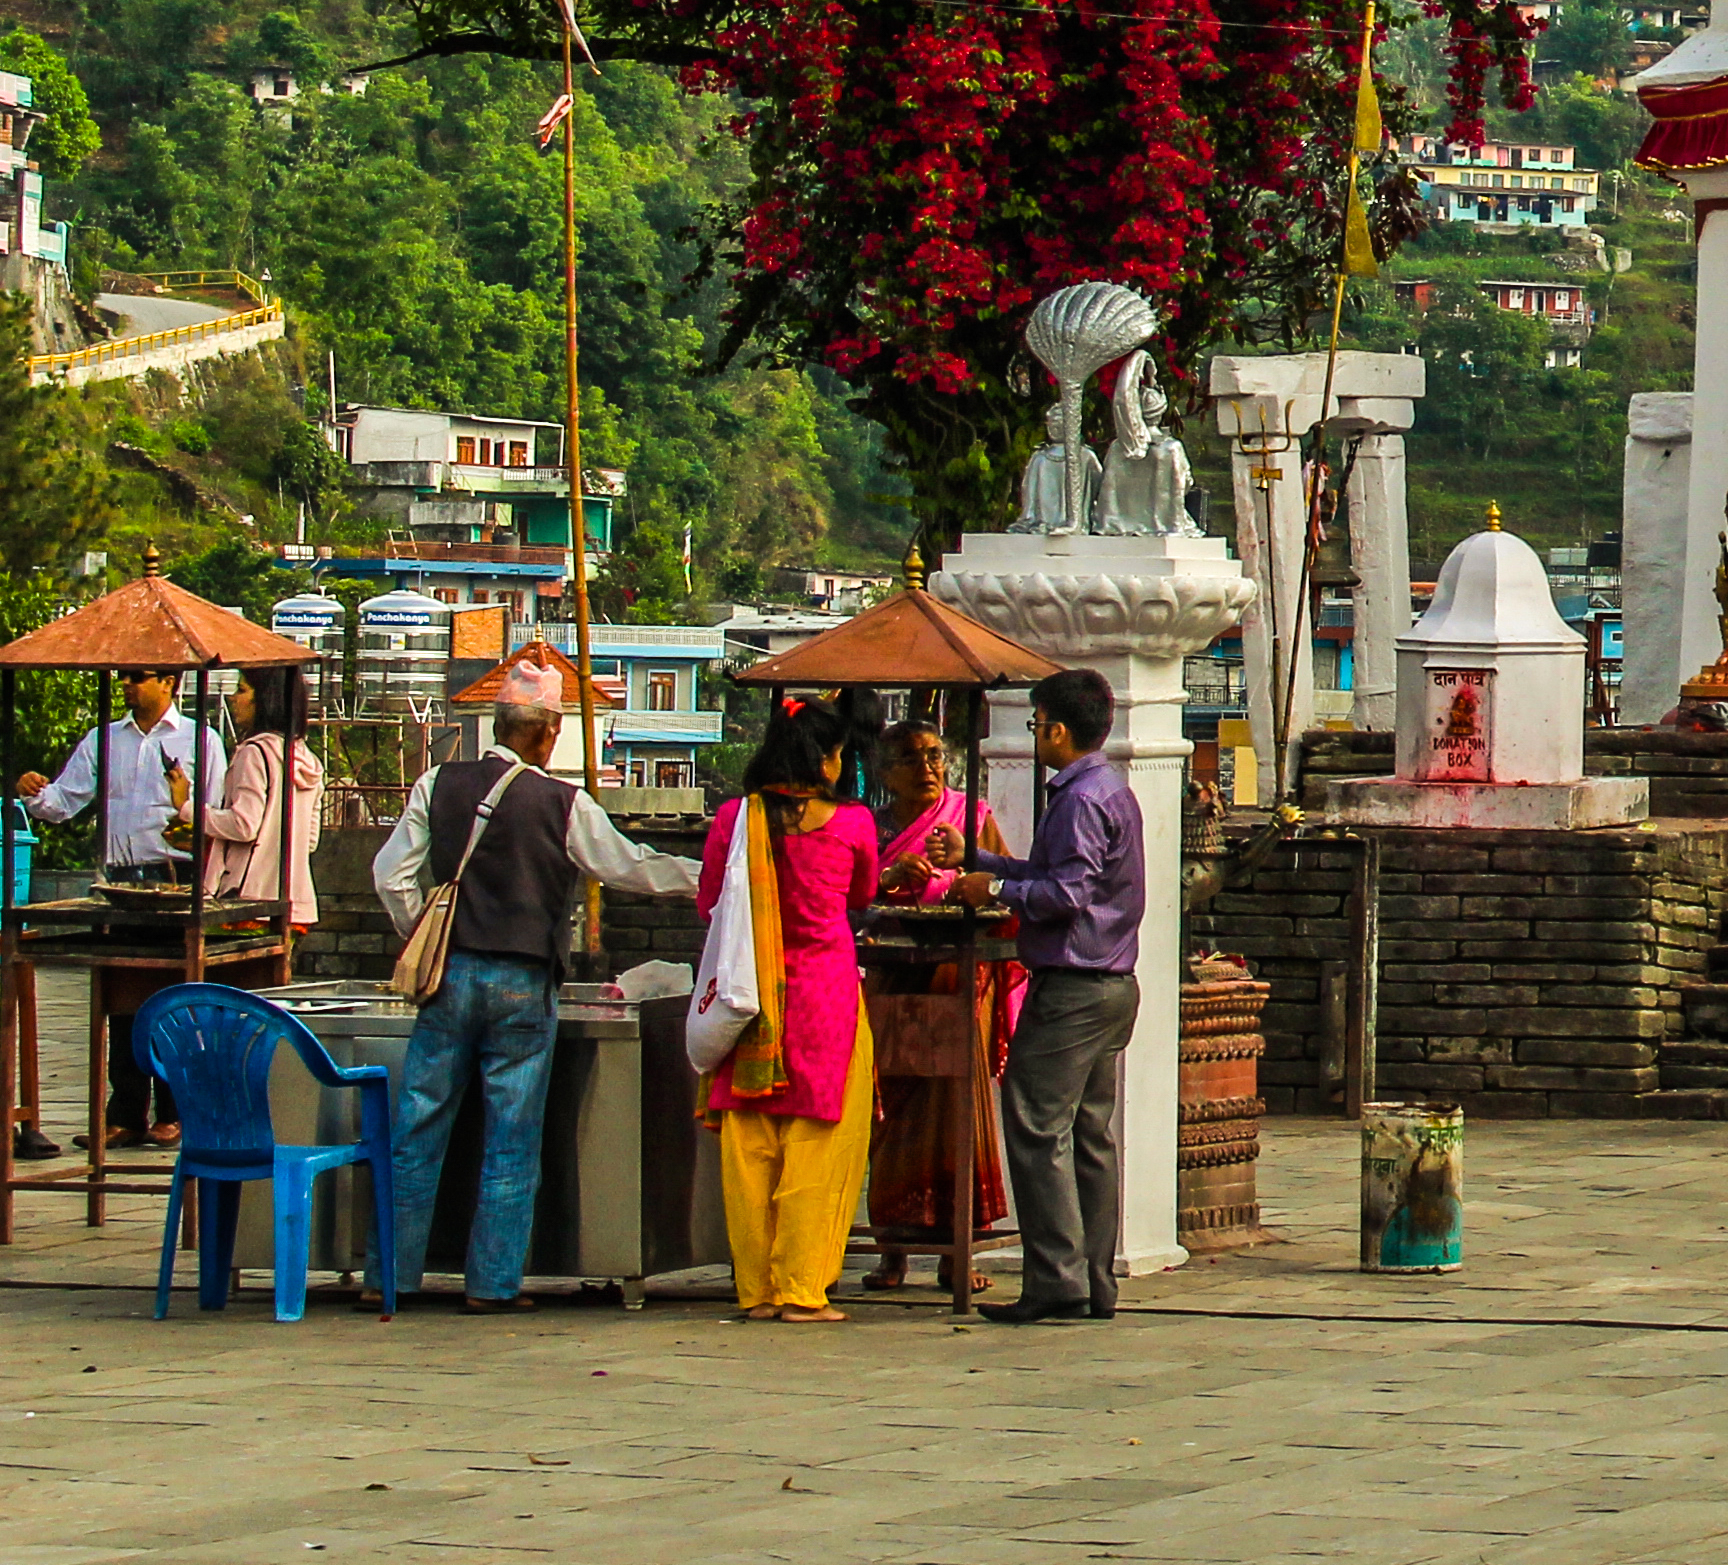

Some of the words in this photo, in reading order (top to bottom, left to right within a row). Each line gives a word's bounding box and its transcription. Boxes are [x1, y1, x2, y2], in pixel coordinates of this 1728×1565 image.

[367, 612, 430, 625] Panchakanya
[1433, 672, 1457, 688] दान
[1433, 737, 1485, 750] DONATION
[1447, 752, 1474, 767] BOX
